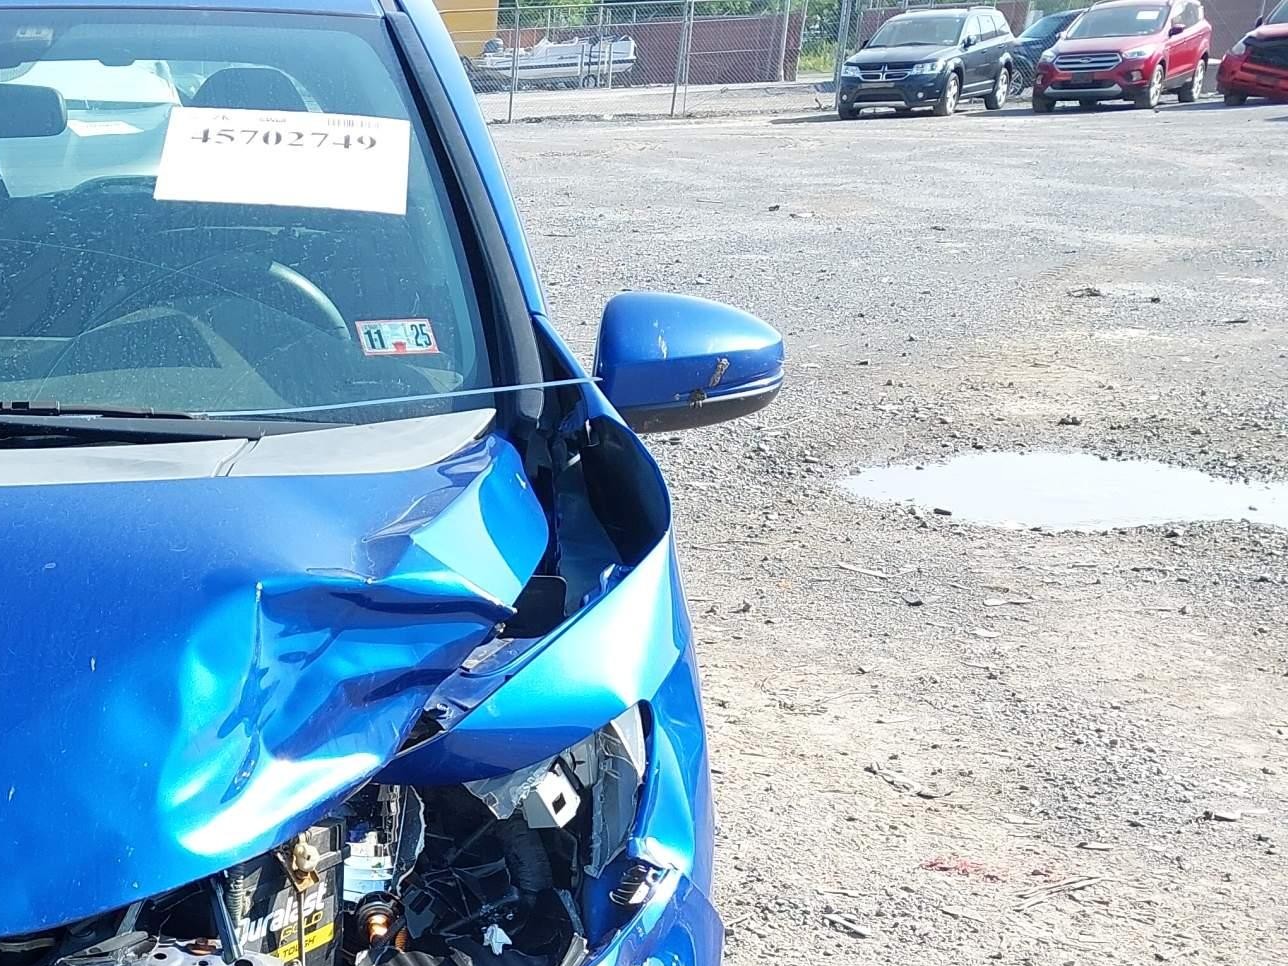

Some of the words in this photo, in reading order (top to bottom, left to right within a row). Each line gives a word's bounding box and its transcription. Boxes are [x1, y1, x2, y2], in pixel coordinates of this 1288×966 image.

[192, 127, 377, 150] 45702749
[364, 329, 386, 349] 11
[410, 323, 433, 347] 25
